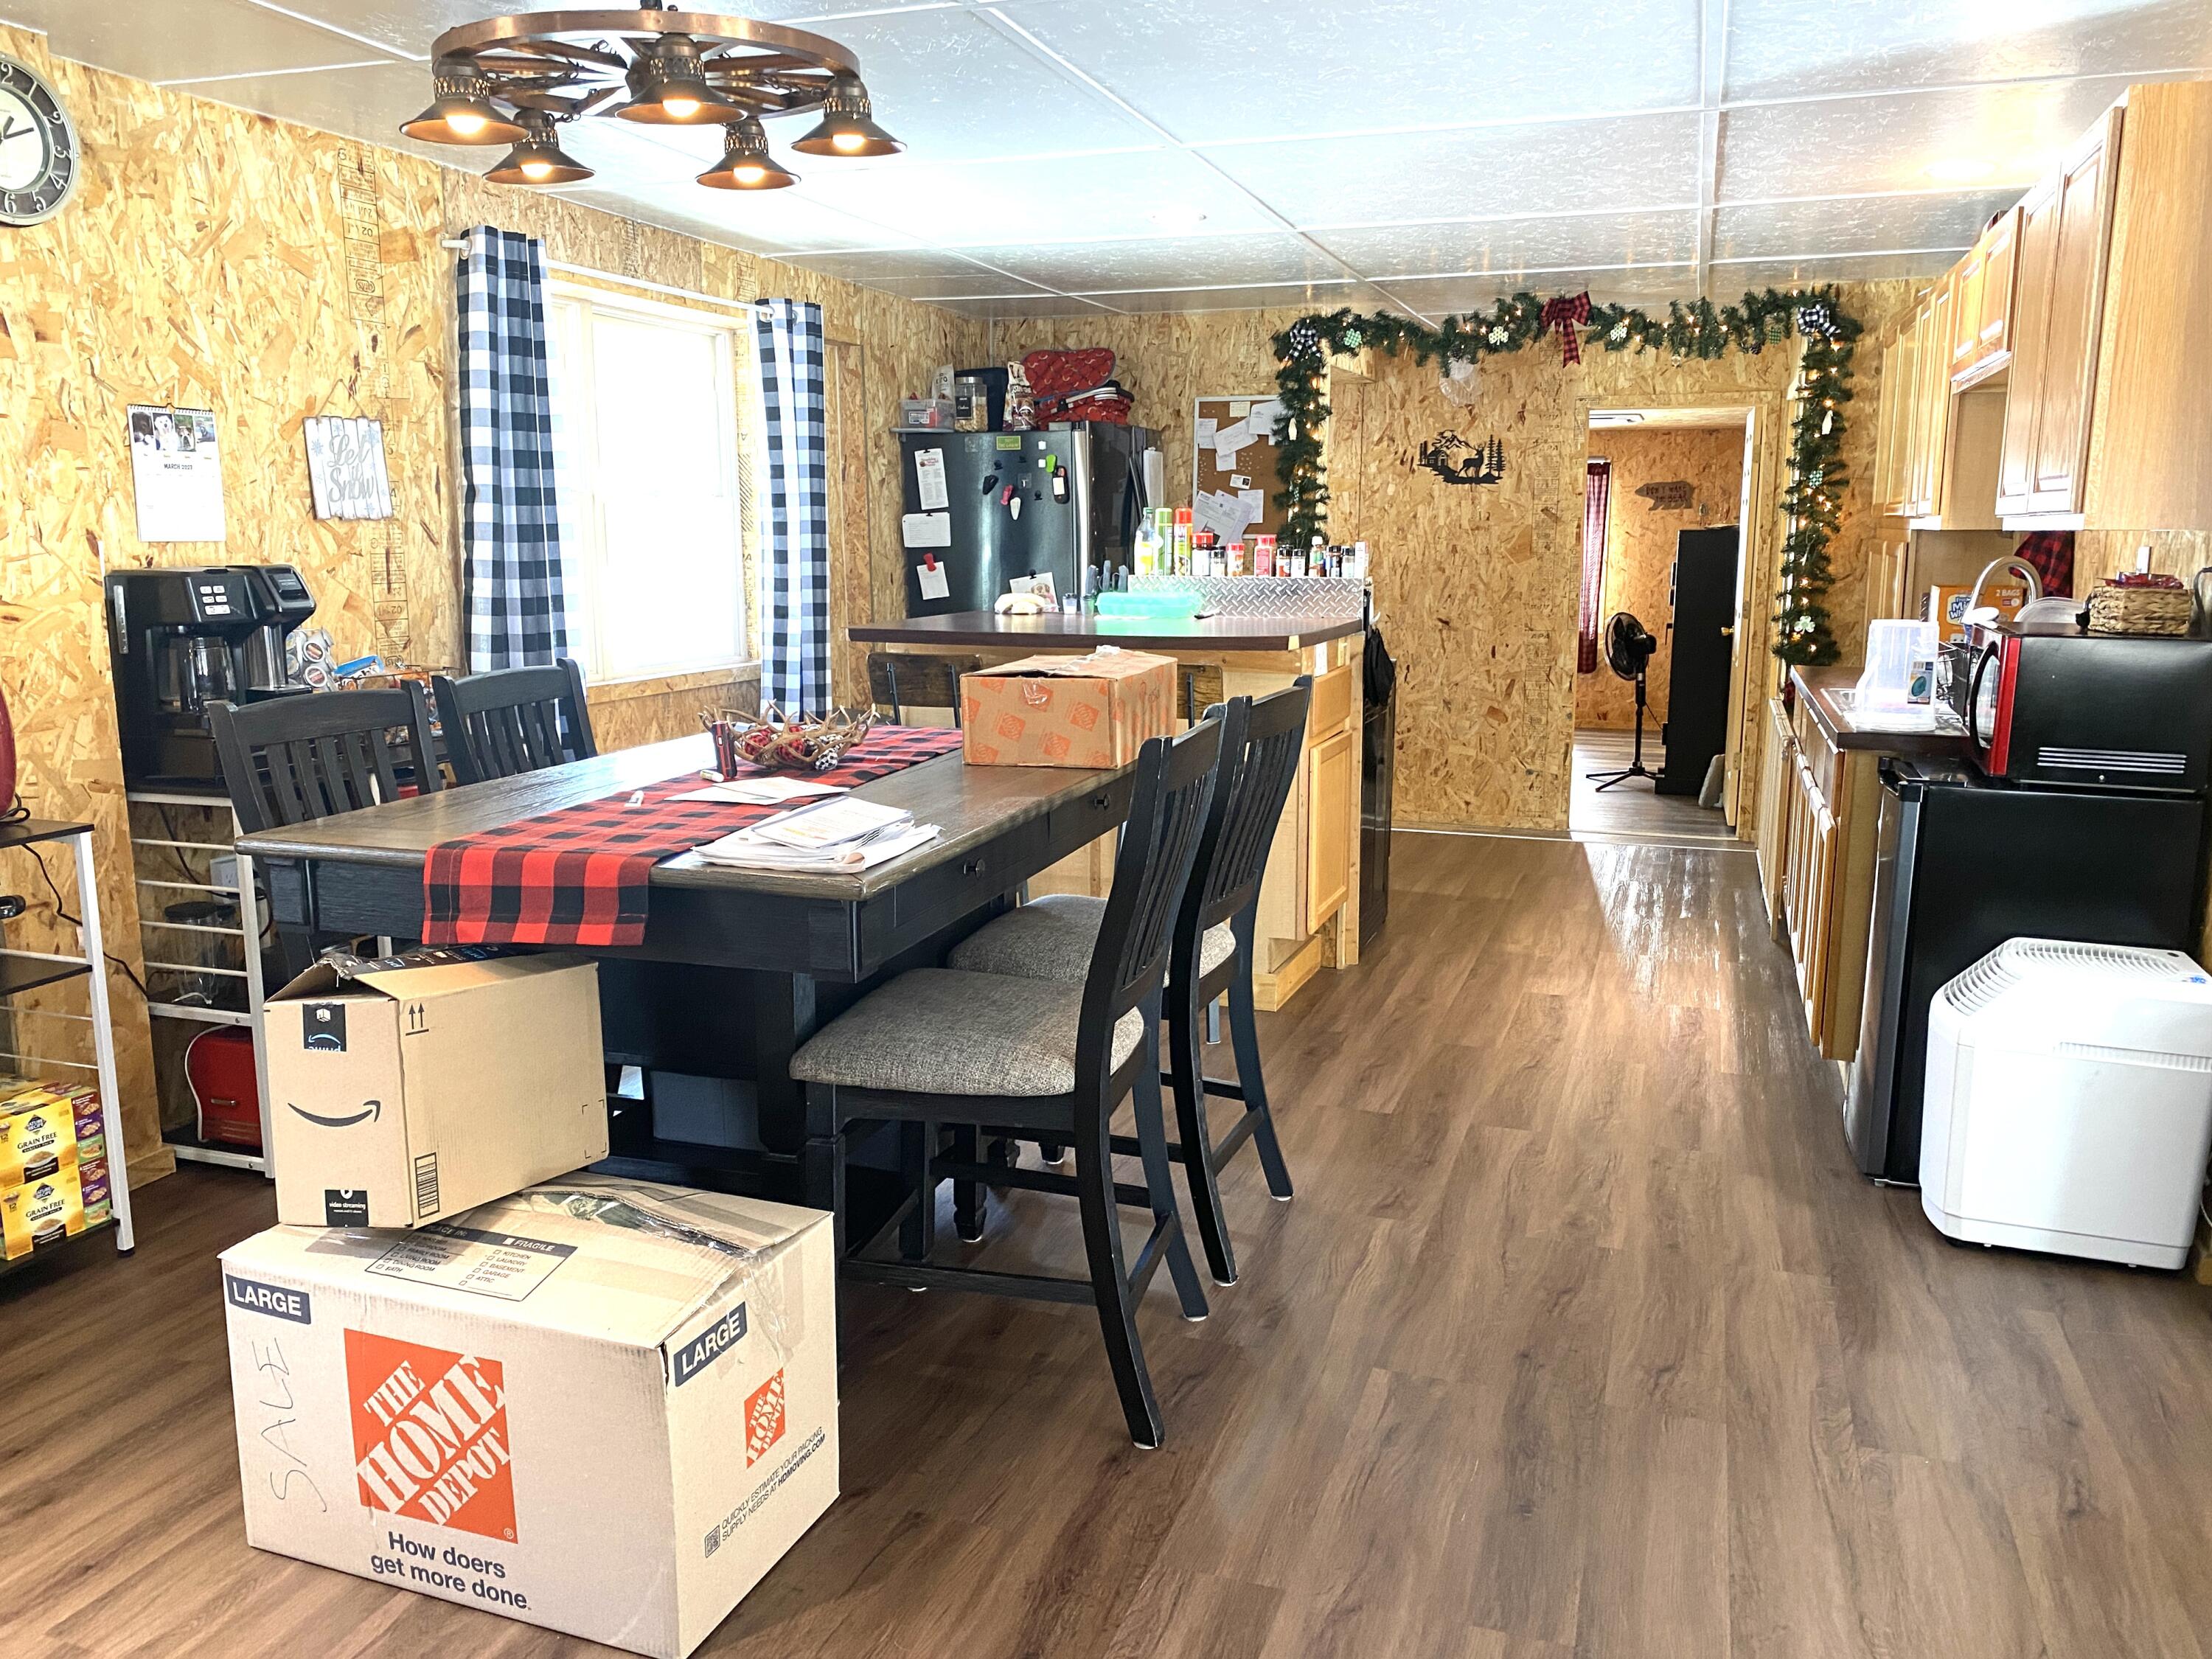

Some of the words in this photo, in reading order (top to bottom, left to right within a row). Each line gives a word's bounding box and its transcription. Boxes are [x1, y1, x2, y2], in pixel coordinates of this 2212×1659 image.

[0, 63, 13, 86] 2
[44, 111, 63, 128] 2
[54, 145, 72, 160] 3
[49, 171, 67, 189] 4
[4, 192, 17, 214] 6
[31, 189, 46, 212] 5
[327, 434, 370, 467] Let
[328, 467, 374, 503] Snow
[17, 1138, 41, 1150] GRAIN
[41, 1132, 58, 1142] FREE
[26, 1206, 48, 1217] GRAIN
[49, 1199, 65, 1209] FREE
[343, 1202, 366, 1210] streaming
[408, 1248, 428, 1256] FAMILY
[503, 1251, 531, 1259] KITCHEN
[514, 1239, 555, 1252] FRAGILE
[400, 1253, 420, 1262] LIVING
[489, 1263, 525, 1273] BASEMENT
[495, 1256, 527, 1267] LAUNDRY
[476, 1275, 495, 1284] ATTIC
[482, 1269, 511, 1279] GARAGE
[232, 1281, 302, 1317] LARGE
[681, 1312, 740, 1376] LARGE
[363, 1359, 426, 1427] THE
[746, 1373, 784, 1461] HOME
[749, 1393, 766, 1427] THE
[762, 1393, 785, 1450] DEPOT
[251, 1338, 327, 1512] SALE
[356, 1354, 506, 1514] HOME
[418, 1427, 512, 1526] DEPOT
[721, 1497, 750, 1530] QUICKLY
[751, 1467, 780, 1503] ESTIMATE
[780, 1450, 797, 1472] YOUR
[798, 1426, 822, 1455] PACKING
[722, 1512, 748, 1541] SUPPLY
[748, 1489, 769, 1516] NEEDS
[770, 1483, 777, 1495] AT
[778, 1433, 826, 1487] HDMOVING.COM
[388, 1531, 436, 1561] How
[442, 1546, 507, 1579] doers
[370, 1554, 406, 1577] get
[410, 1565, 466, 1593] more
